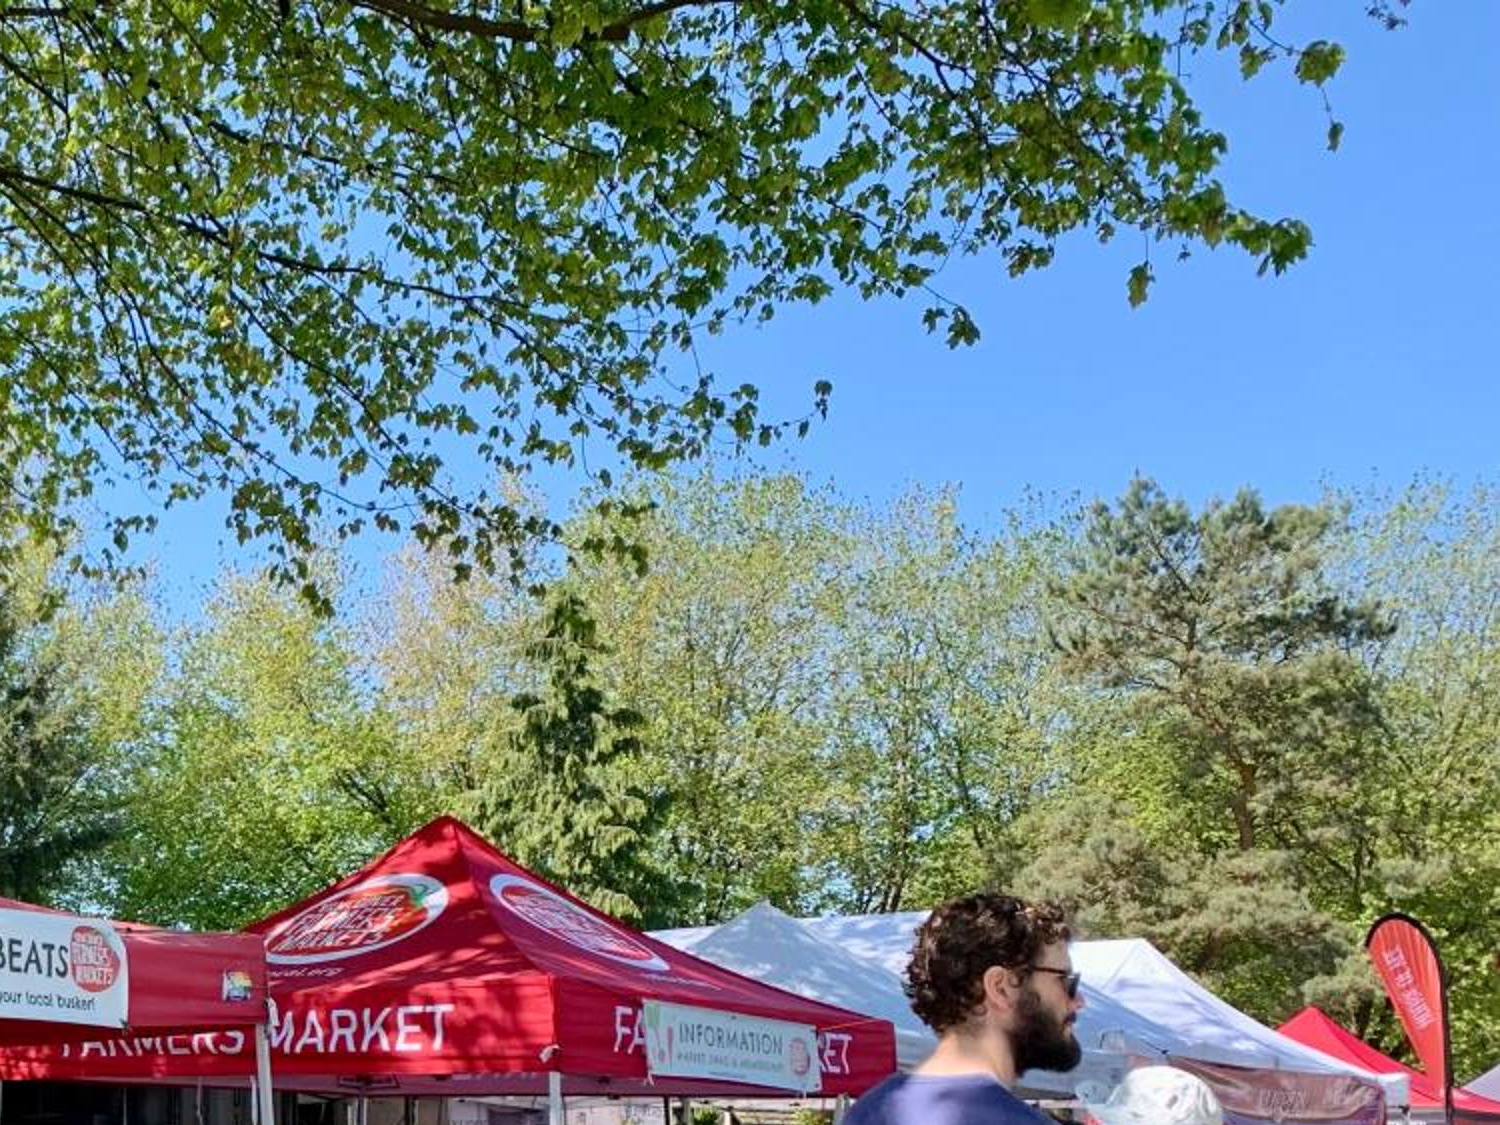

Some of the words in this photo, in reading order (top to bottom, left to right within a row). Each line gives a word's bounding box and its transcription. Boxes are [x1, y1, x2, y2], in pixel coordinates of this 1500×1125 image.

[25, 991, 54, 1007] local
[267, 1003, 454, 1055] MARKET
[679, 1022, 783, 1056] INFORMATION
